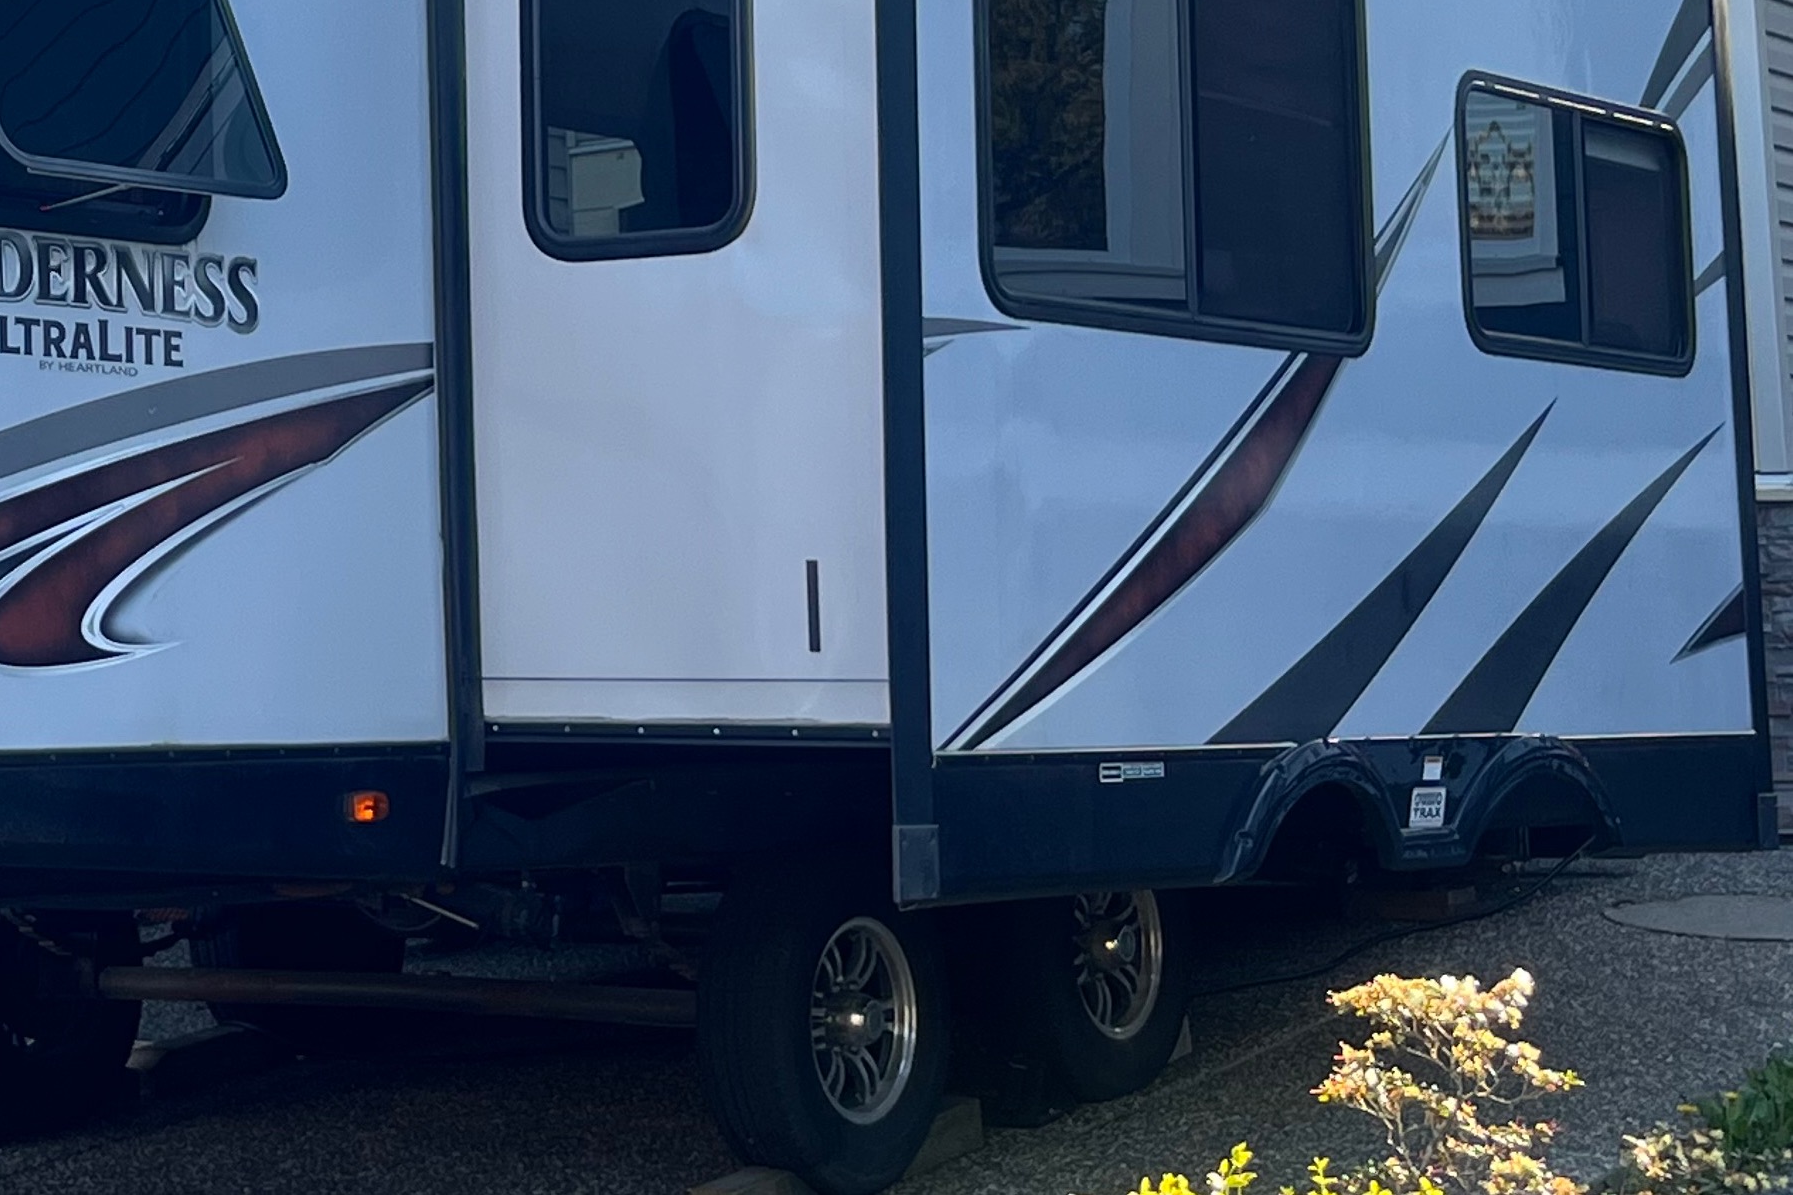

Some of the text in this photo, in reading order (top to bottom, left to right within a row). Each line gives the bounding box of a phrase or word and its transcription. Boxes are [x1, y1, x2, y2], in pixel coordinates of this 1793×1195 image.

[39, 360, 138, 377] BY HEARTLAND
[1413, 807, 1441, 819] TRAX
